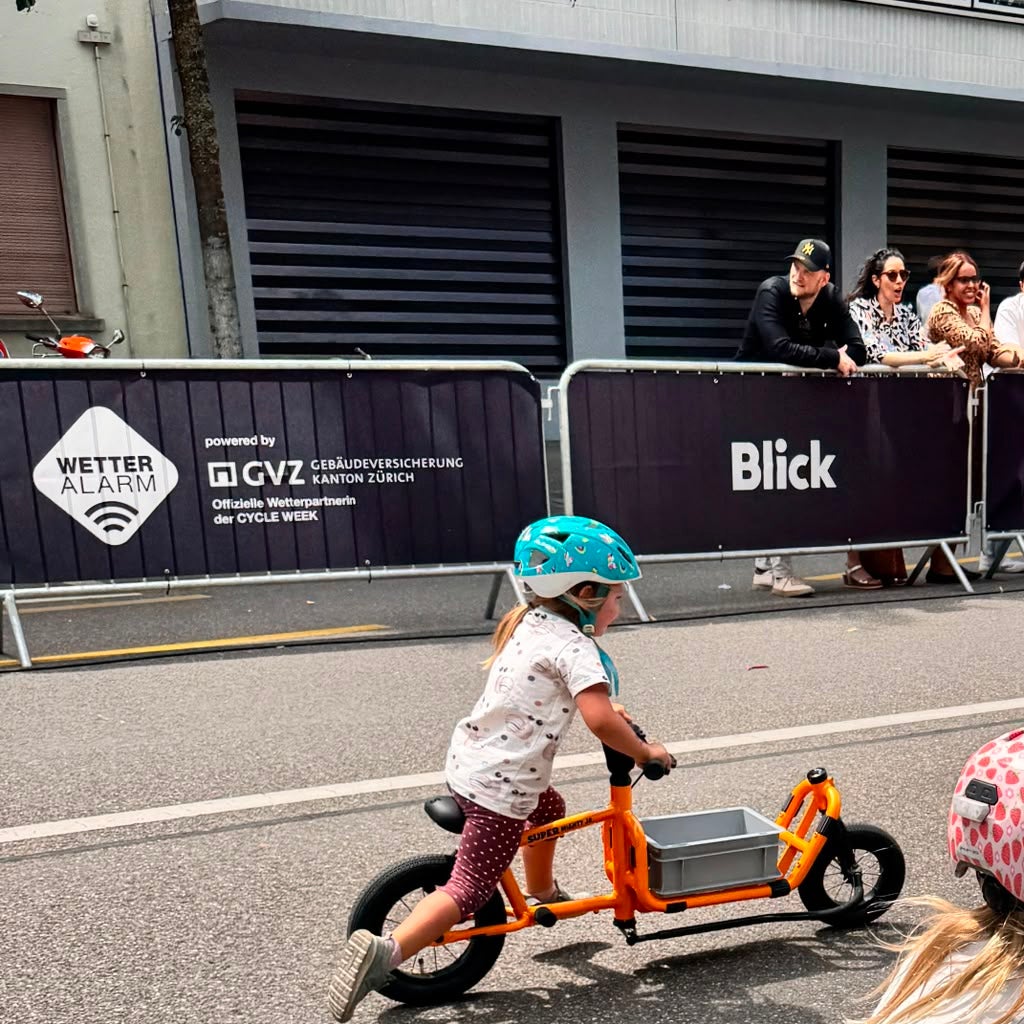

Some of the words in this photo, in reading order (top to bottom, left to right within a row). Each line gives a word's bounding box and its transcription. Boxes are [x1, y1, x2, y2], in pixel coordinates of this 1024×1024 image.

[205, 435, 259, 448] powered
[260, 435, 276, 447] by
[56, 455, 154, 474] WETTER
[310, 456, 464, 470] GEBÄUDEVERSICHERUNG
[731, 438, 837, 491] Blick
[242, 460, 306, 487] GVZ
[312, 472, 364, 485] KANTON
[367, 470, 415, 483] ZÜRICH
[61, 474, 157, 495] ALARM
[212, 498, 265, 510] Offizielle
[266, 495, 357, 509] Wetterpartnerin
[213, 514, 235, 525] der
[236, 511, 280, 524] CYCLE
[281, 510, 320, 522] WEEK
[527, 827, 560, 843] SUPER
[560, 820, 584, 832] MIGHTY
